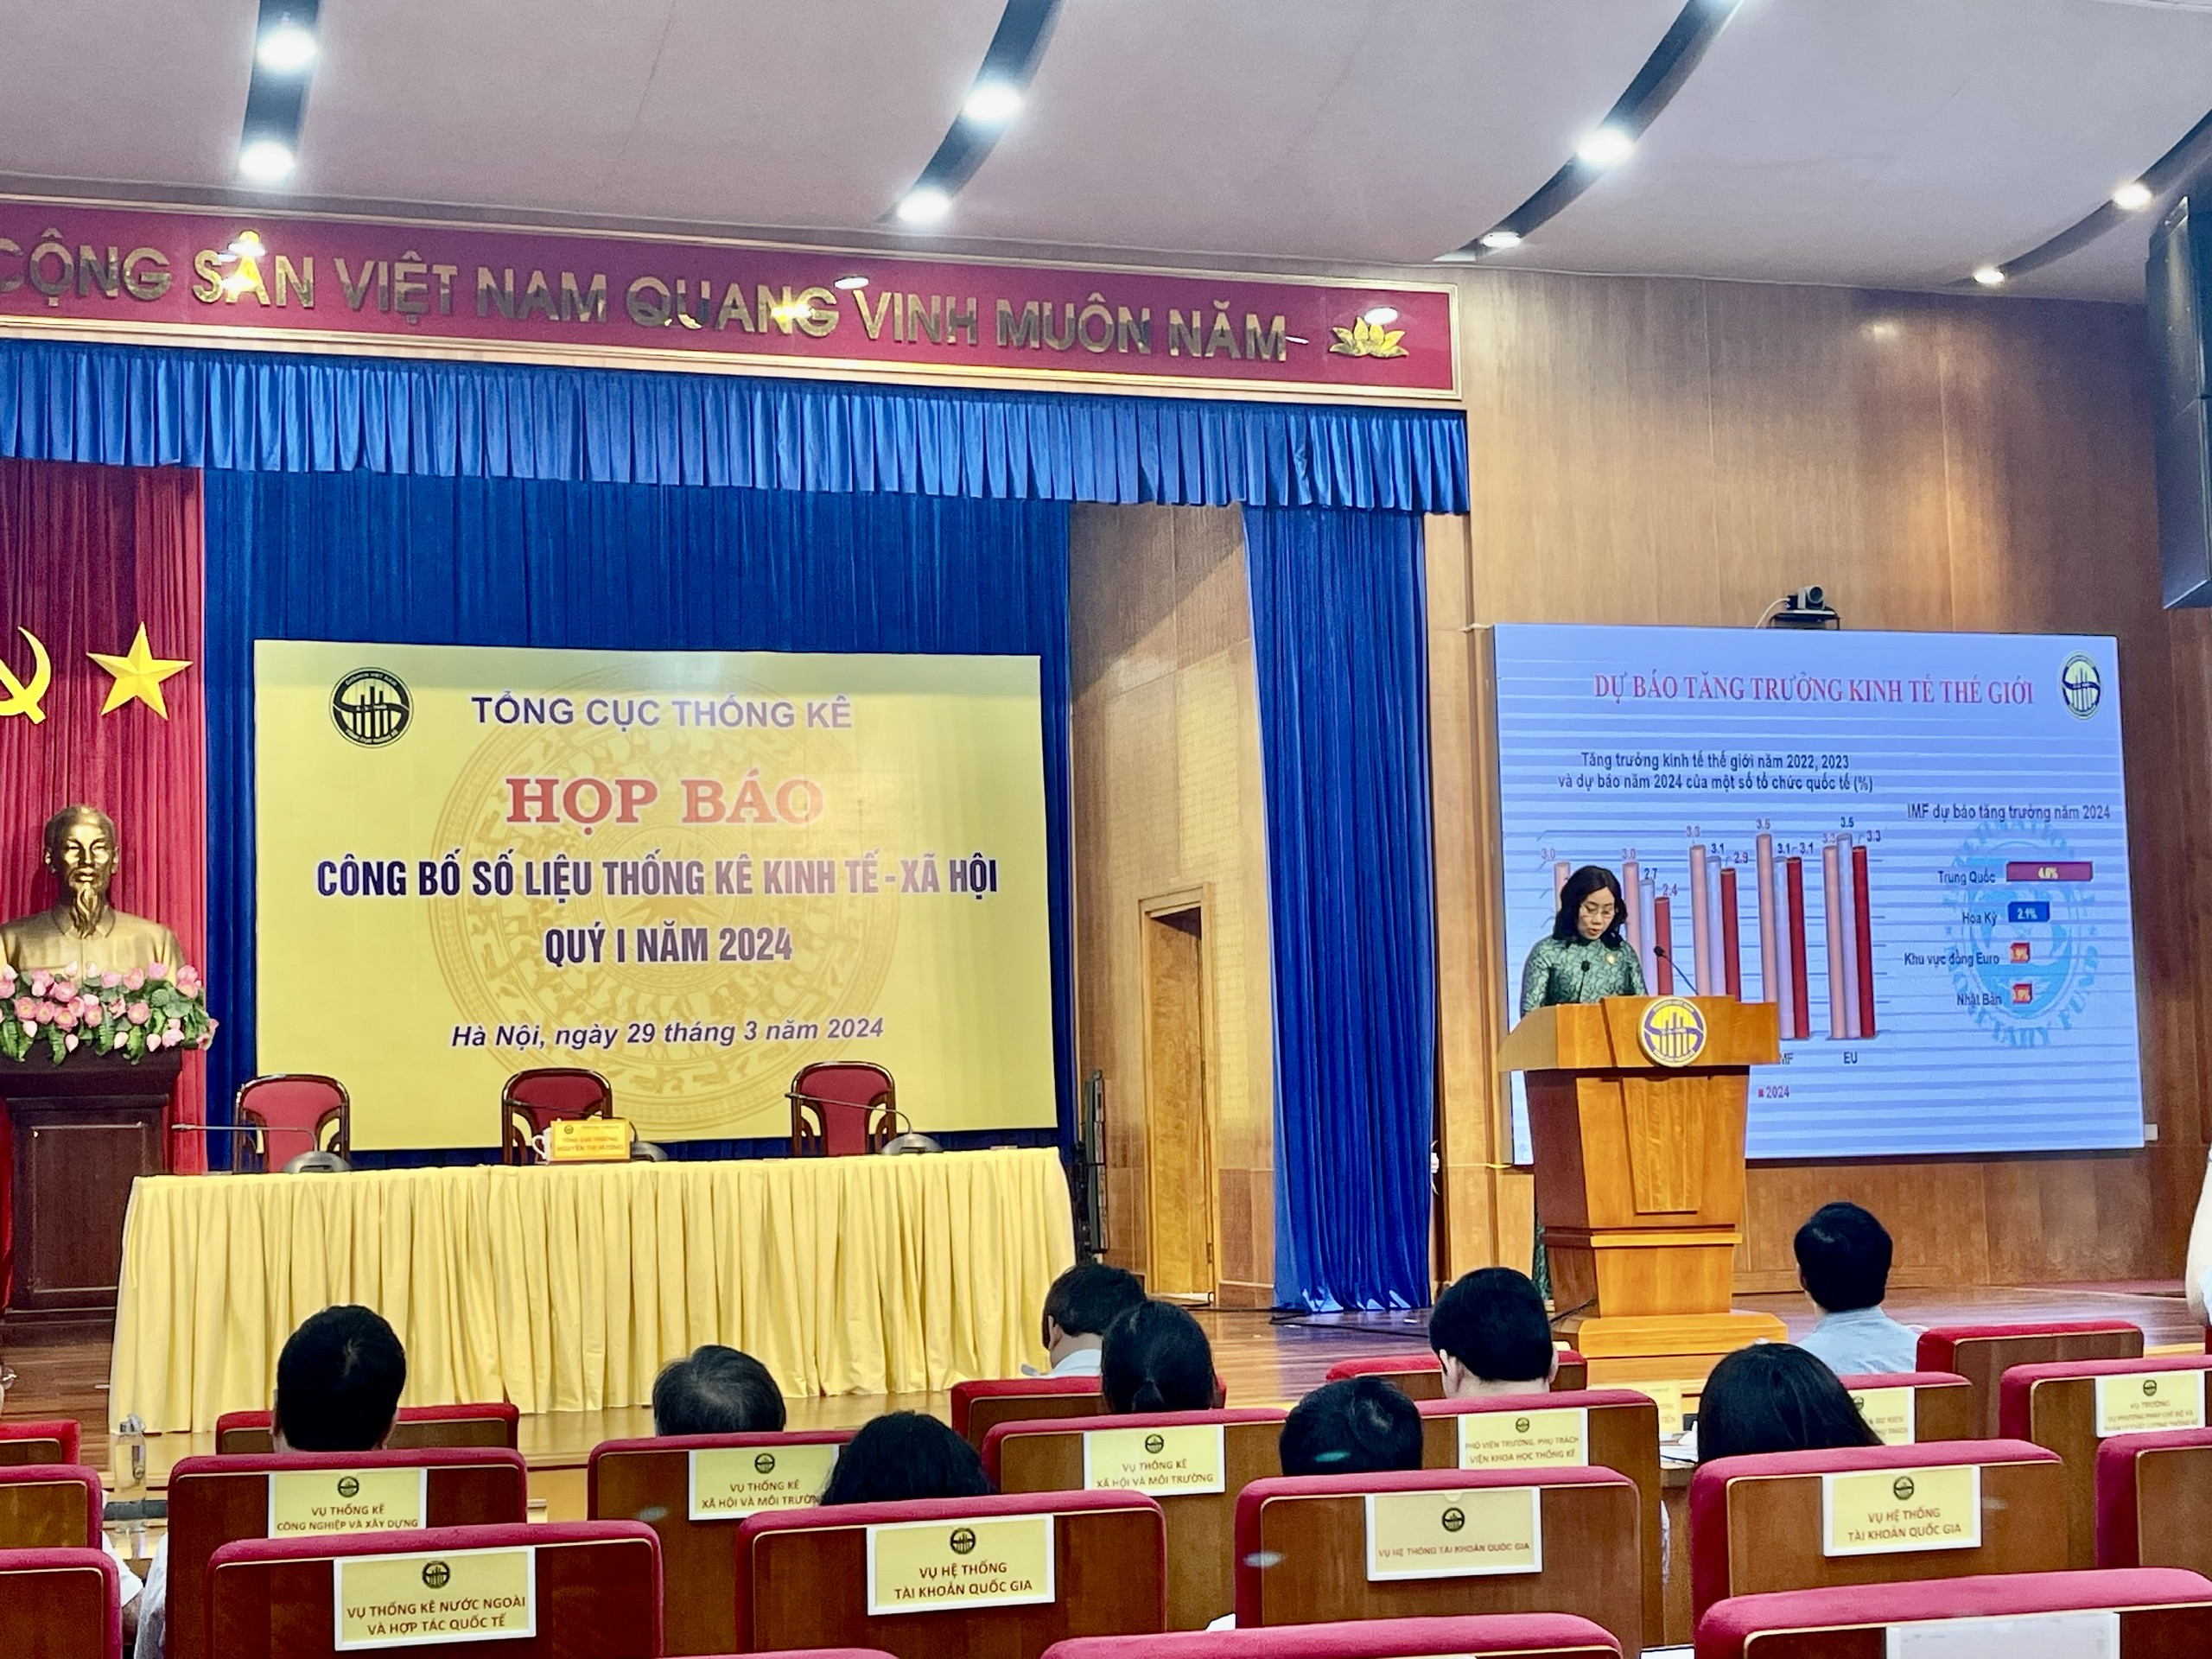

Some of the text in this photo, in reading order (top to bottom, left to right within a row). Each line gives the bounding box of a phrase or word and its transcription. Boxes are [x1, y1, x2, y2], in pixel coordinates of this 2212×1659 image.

[334, 251, 458, 325] VIỆT
[478, 266, 606, 323] NAM
[626, 276, 840, 337] QUANG
[853, 289, 978, 346] VINH
[996, 292, 1151, 354] MUÔN
[1168, 299, 1287, 362] NĂM
[1595, 669, 2035, 705] DỰ BÁO TĂNG TRƯỞNG KINH TẾ THẾ GIỚI
[471, 689, 853, 733] TỔNG CỤC THỐNG KÊ
[1580, 749, 1849, 772] Tăng trưởng kinh tế thế giới năm 2022, 2023
[1557, 771, 1873, 793] và dự báo năm 2024 của một số chức quốc tế (%)
[505, 767, 824, 836] HỌP BÁO
[1906, 803, 1929, 819] IMF
[1932, 803, 1950, 823] dự
[1953, 803, 1976, 819] báo
[1978, 804, 2005, 823] tăng
[2054, 804, 2079, 820] năm
[2082, 804, 2111, 820] 2024
[1840, 816, 1854, 829] 3.5
[1866, 830, 1881, 842] 3.3
[1541, 847, 1556, 861] 3.0
[1621, 848, 1637, 861] 3.0
[1710, 842, 1725, 855] 3.1
[1777, 842, 1790, 855] 3.1
[1799, 842, 1814, 855] 3.1
[1733, 851, 1749, 864] 2.9
[317, 849, 997, 904] CÔNG BỐ SỐ LIỆU THỐNG KÊ KINH TẾ XÃ HỘI
[1643, 867, 1658, 880] 2.7
[1937, 868, 1996, 886] Trung Quốc
[1662, 883, 1678, 896] 2.4
[545, 920, 793, 967] QUÝ I NĂM 2024
[1904, 952, 1925, 966] Khu
[1926, 953, 1946, 969] vực
[1975, 951, 2000, 965] Euro
[451, 1017, 885, 1051] Hà Nội, ngày 29 tháng 3 năm 2024
[1843, 1051, 1859, 1065] EU
[1765, 1085, 1790, 1099] 2024
[1491, 1452, 1515, 1462] KHOA
[1122, 1463, 1136, 1473] VỤ
[730, 1478, 799, 1494] VỤ THỐNG KÊ
[1096, 1472, 1214, 1488] XÃ HỘI VÀ MÔI TRƯỜNG
[312, 1503, 385, 1517] VỤ THỐNG KÊ
[702, 1494, 779, 1510] XÃ HỘI VÀ MÔI
[1867, 1506, 1941, 1524] VỤ HỆ THỐNG
[276, 1518, 418, 1531] CÔNG NGHIỆP VÀ XÂY DỰNG
[1847, 1522, 1961, 1542] TÀI KHOẢN QUỐC GIA
[1378, 1549, 1390, 1559] VỤ
[1439, 1545, 1453, 1554] TÀI
[1515, 1541, 1531, 1551] GIA
[919, 1560, 1007, 1581] VỤ HỆ THỐNG
[894, 1579, 1033, 1599] TÀI KHOẢN QUỐC GIA
[346, 1594, 526, 1620] VỤ THỐNG KÊ NƯỚC NGOÀI
[367, 1612, 508, 1636] VÀ HỢP TÁC QUỐC TẾ
